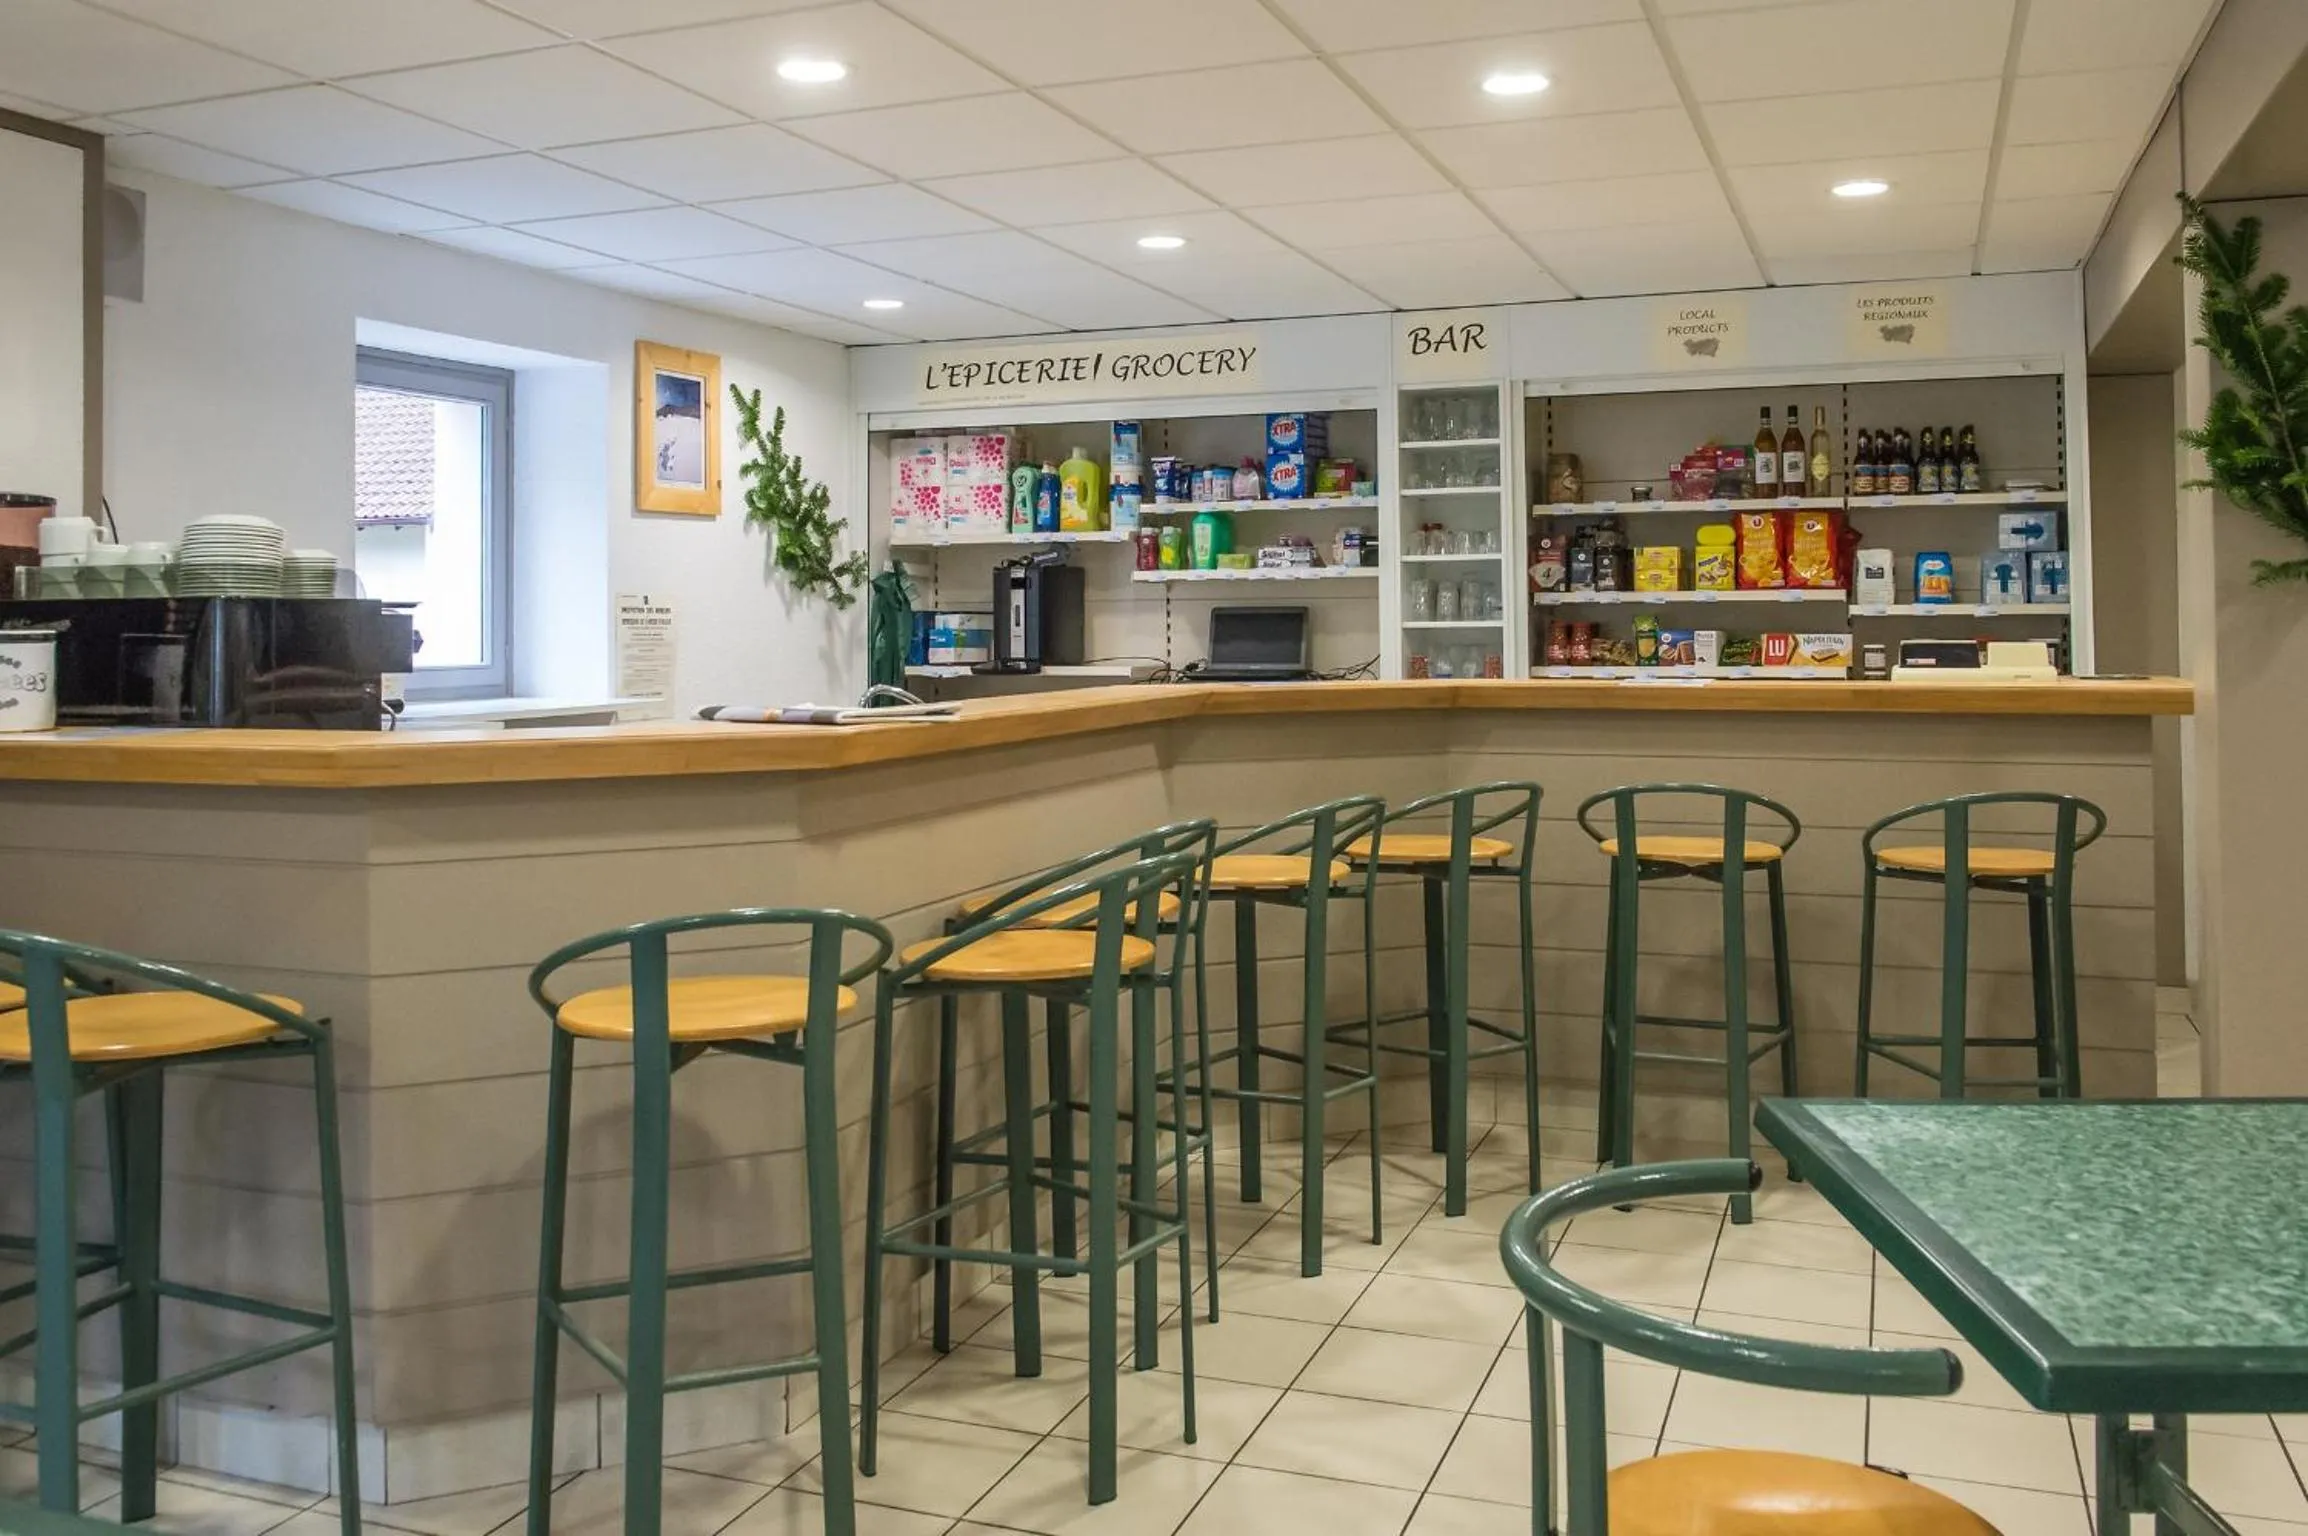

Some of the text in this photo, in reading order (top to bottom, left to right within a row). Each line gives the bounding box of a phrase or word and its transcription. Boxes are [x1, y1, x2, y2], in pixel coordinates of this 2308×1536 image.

[1877, 295, 1934, 307] PRODUITS
[1679, 308, 1716, 320] LOCAL
[1667, 322, 1729, 336] PRODUCTS
[1408, 323, 1488, 355] BAR
[1111, 347, 1257, 382] GROCERY
[1272, 422, 1296, 436] XTRA
[1273, 467, 1297, 482] XTRA
[1768, 639, 1785, 656] LU
